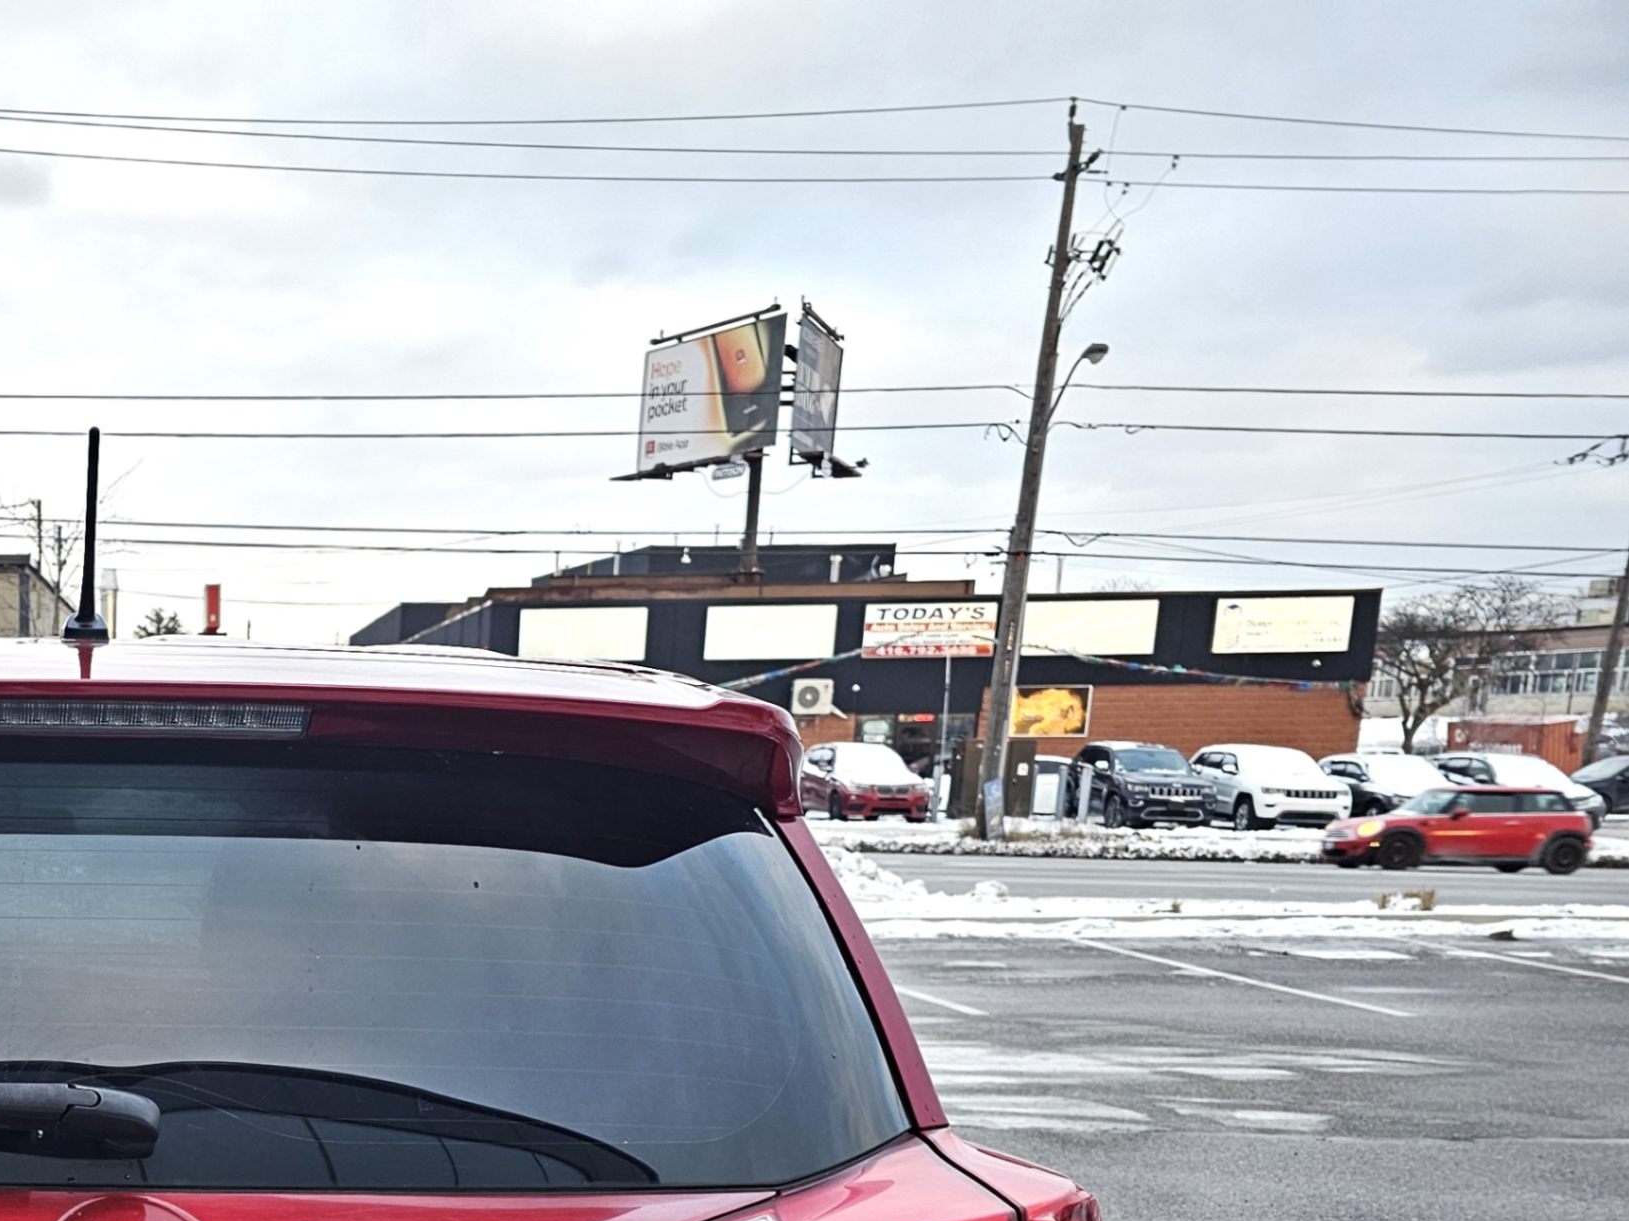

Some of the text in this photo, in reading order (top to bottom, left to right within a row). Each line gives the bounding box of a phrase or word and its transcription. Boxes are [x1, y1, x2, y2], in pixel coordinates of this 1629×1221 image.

[650, 360, 683, 380] Hope
[660, 379, 688, 402] your
[647, 397, 688, 424] pocket
[877, 607, 985, 620] TODAY'S
